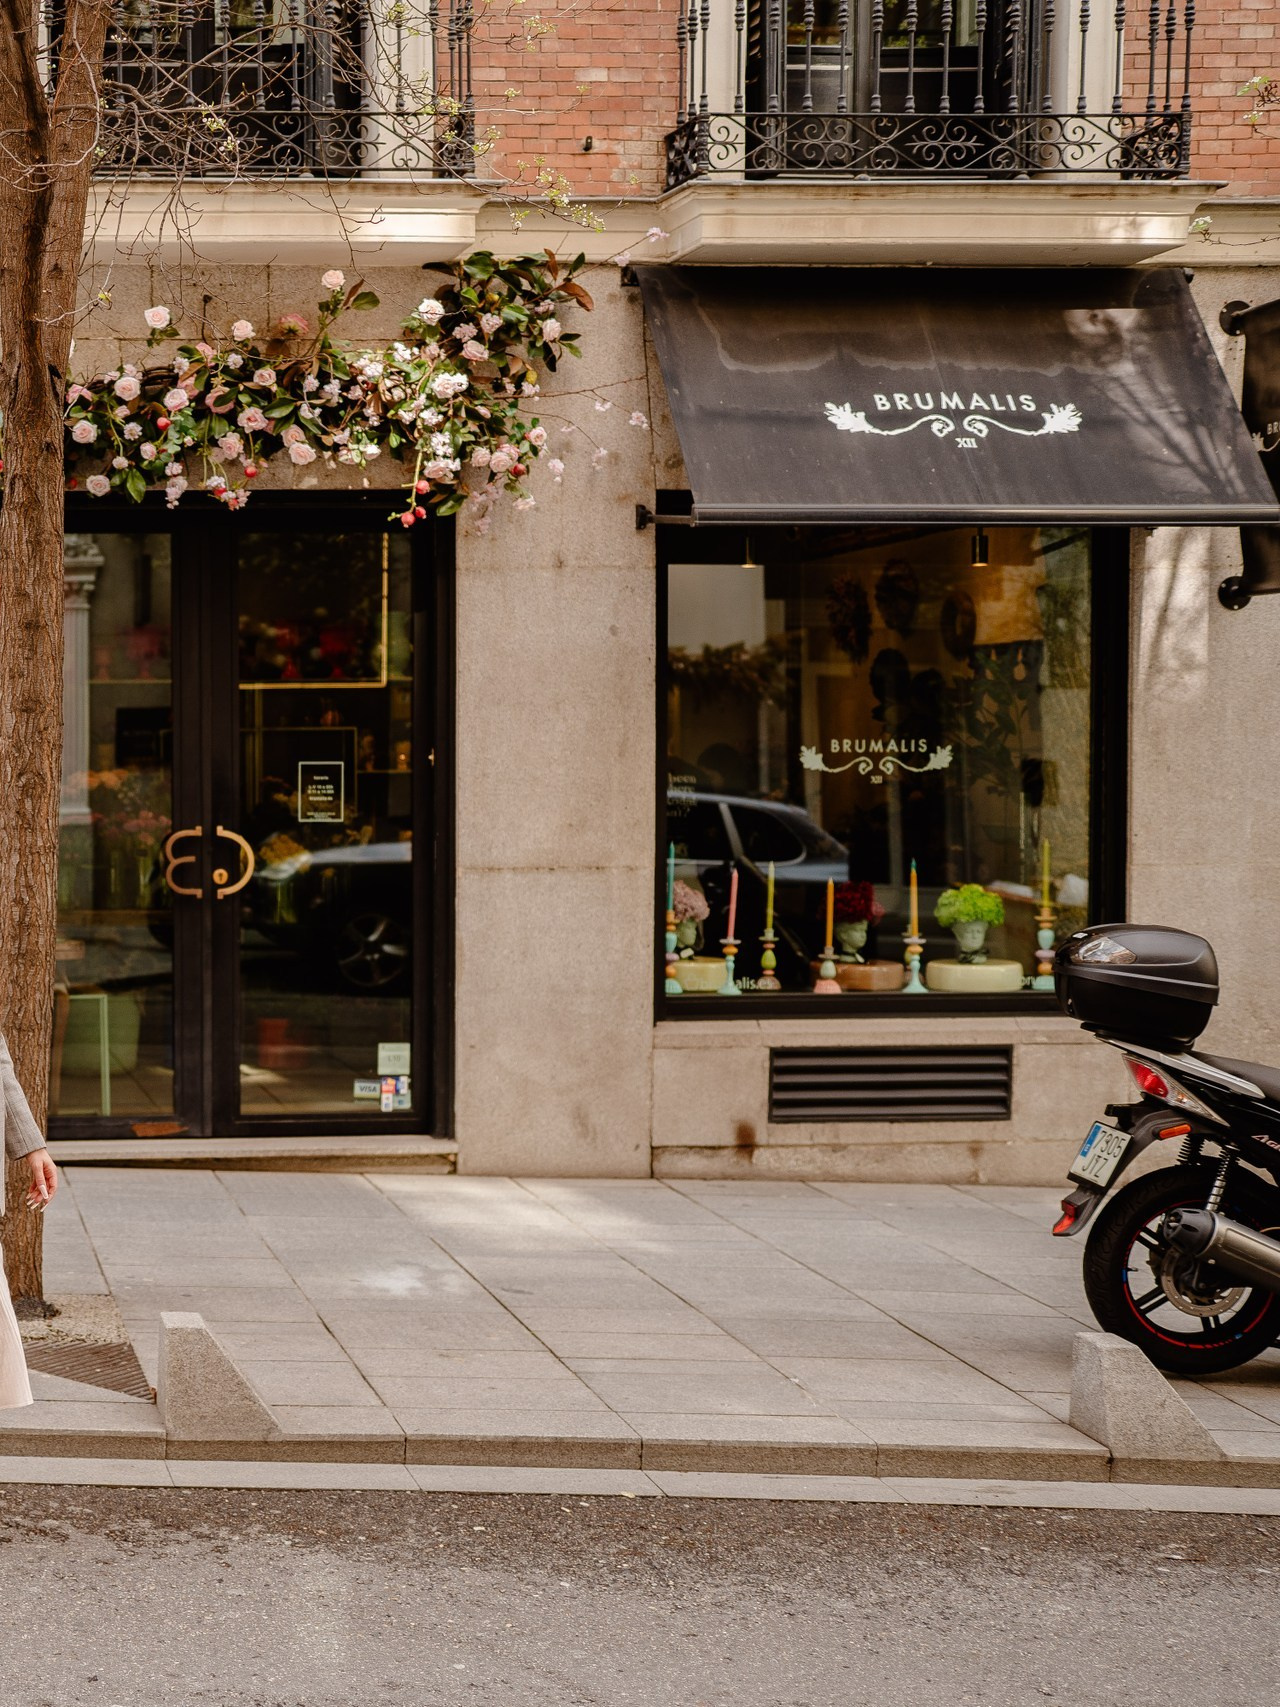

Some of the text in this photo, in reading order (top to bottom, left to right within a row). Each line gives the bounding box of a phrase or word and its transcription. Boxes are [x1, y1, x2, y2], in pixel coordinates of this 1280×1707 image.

[873, 391, 1036, 412] BRUMALIS
[955, 437, 978, 448] XII
[830, 738, 928, 753] BRUMALIS
[1093, 1130, 1126, 1158] 7305
[1081, 1154, 1109, 1178] JTZ
